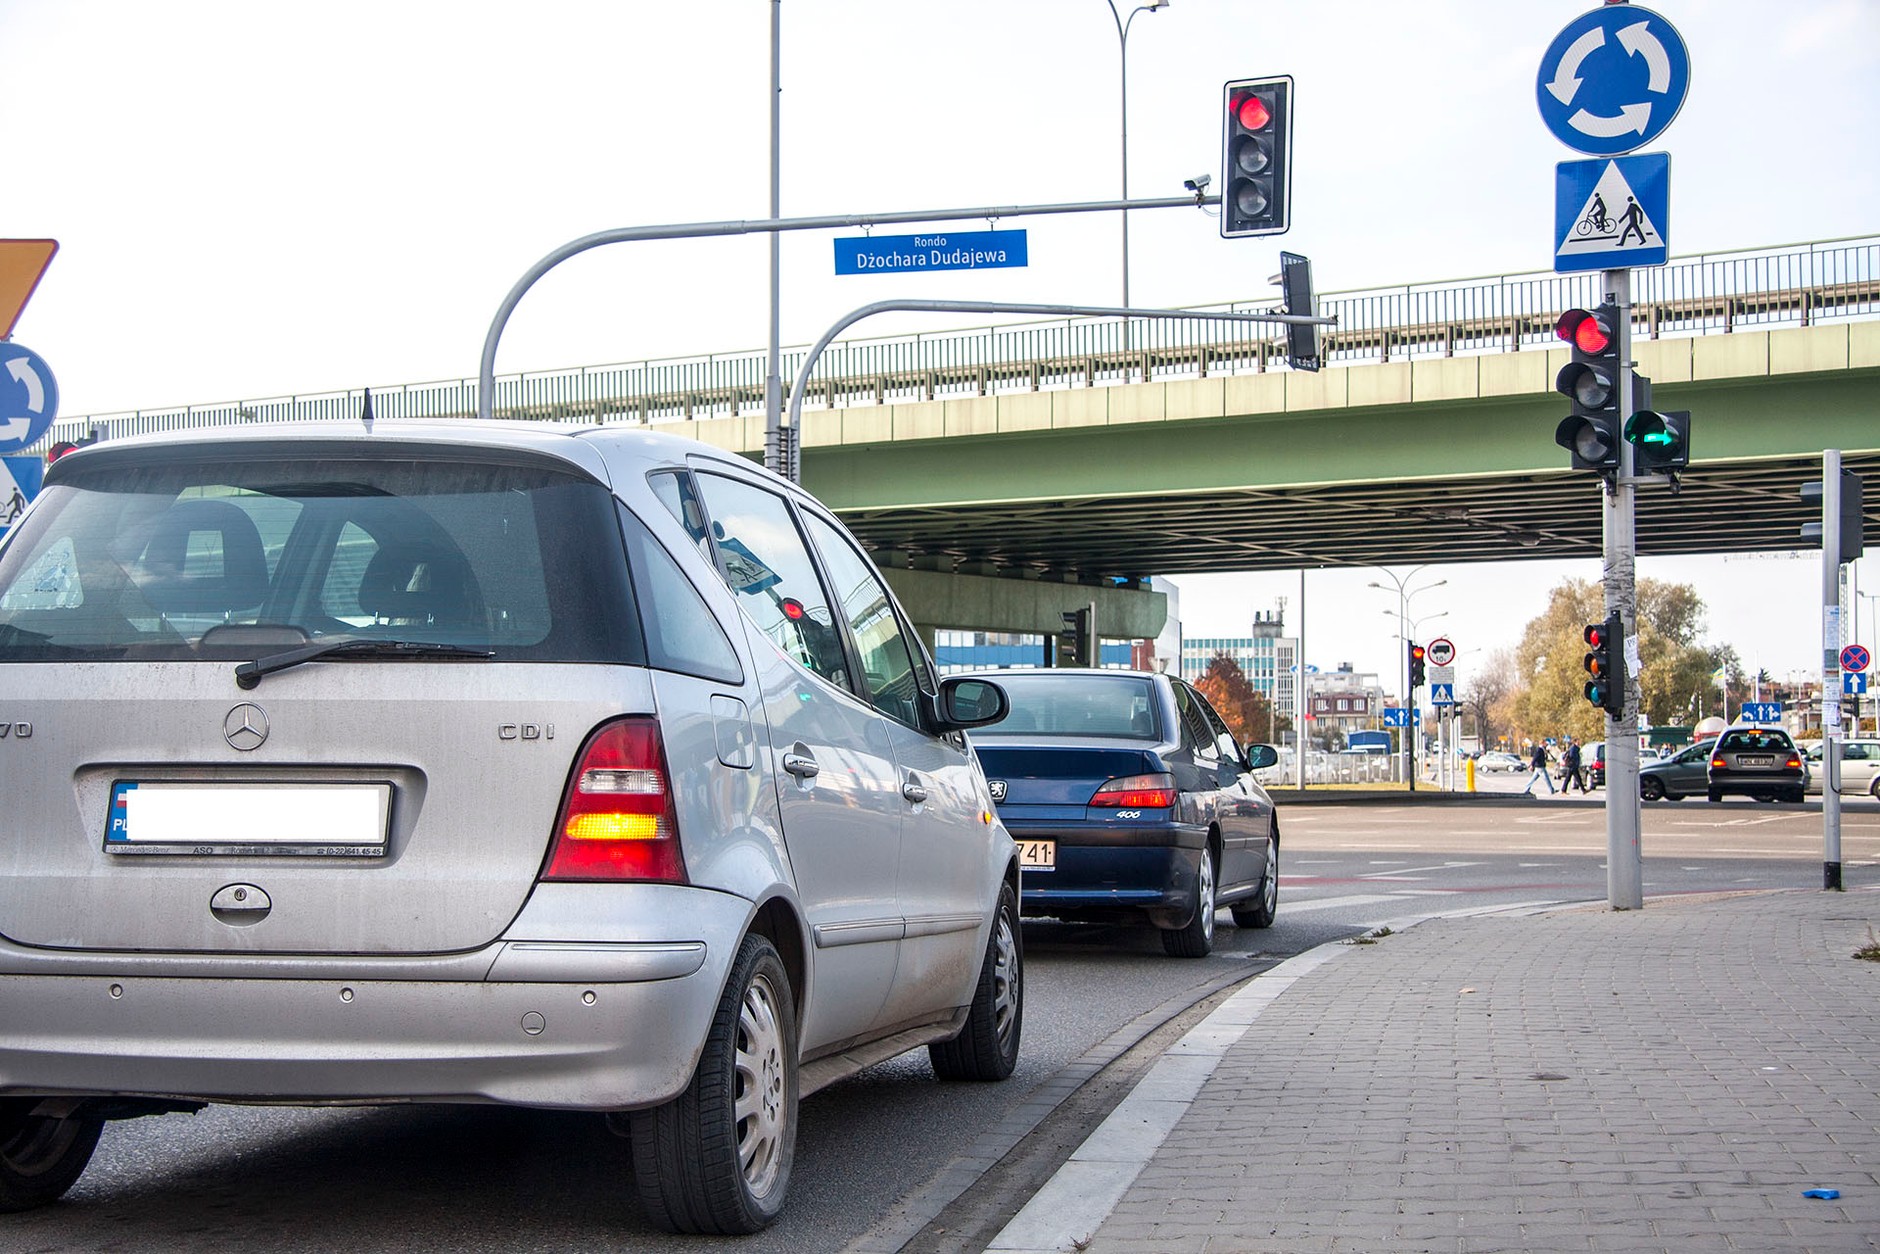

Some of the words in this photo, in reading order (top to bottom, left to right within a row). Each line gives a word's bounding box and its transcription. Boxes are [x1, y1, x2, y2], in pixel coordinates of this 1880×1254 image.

[914, 236, 947, 247] Rondo
[857, 251, 926, 269] Dżochara
[931, 248, 1006, 268] Dudajewa
[498, 723, 554, 740] CDI
[1116, 810, 1141, 819] 406
